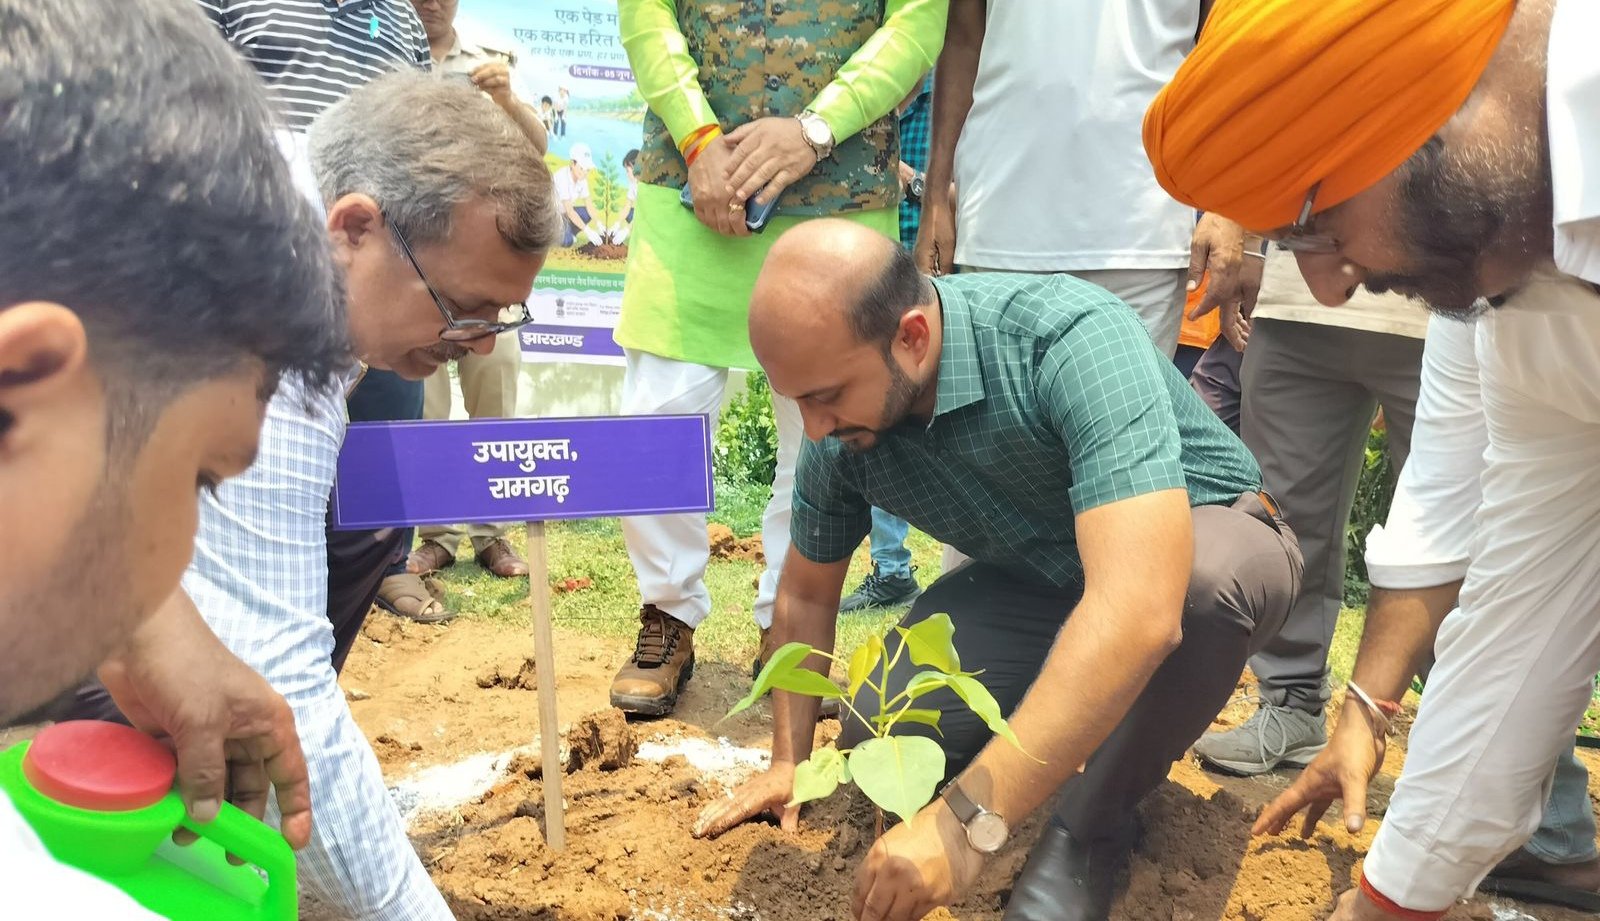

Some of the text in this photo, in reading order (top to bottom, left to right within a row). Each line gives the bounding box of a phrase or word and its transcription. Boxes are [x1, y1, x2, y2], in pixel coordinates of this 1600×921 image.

[554, 9, 580, 24] एक
[582, 6, 604, 27] पेड़
[513, 28, 538, 43] एक
[540, 30, 575, 44] कदम
[578, 29, 615, 47] हरित
[521, 331, 584, 348] झारखण्ड
[471, 437, 578, 472] उपायुक्त,
[487, 474, 571, 504] रामगढ़
